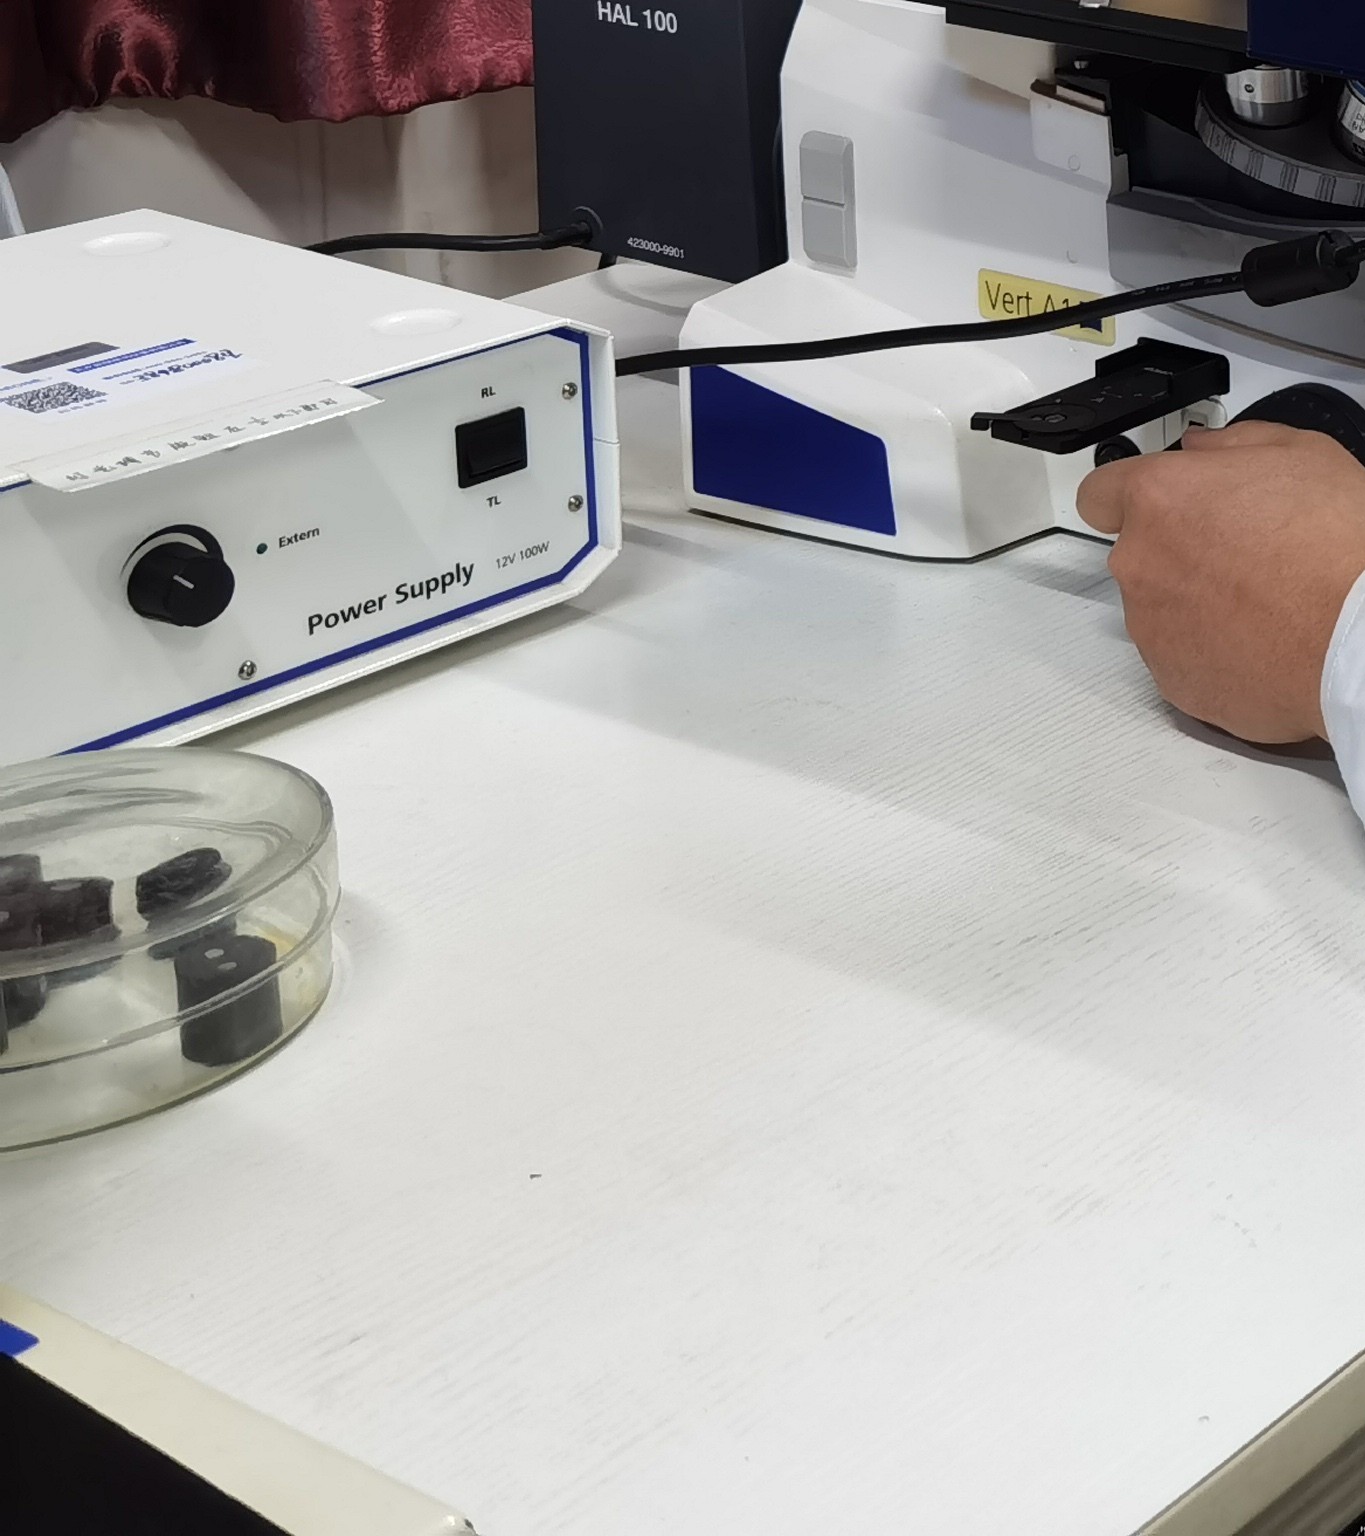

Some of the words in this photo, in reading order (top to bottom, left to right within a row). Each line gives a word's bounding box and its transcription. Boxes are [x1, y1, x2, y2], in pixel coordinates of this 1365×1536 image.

[597, 0, 639, 28] HAL
[642, 7, 679, 35] 100
[626, 235, 686, 260] 423000-9901
[985, 280, 1033, 318] Vert
[481, 385, 497, 399] RL
[486, 495, 502, 509] TL
[278, 526, 321, 549] Extern
[496, 551, 517, 570] 12V
[518, 539, 551, 565] 100W
[307, 589, 388, 636] Power
[394, 561, 476, 606] Supply
